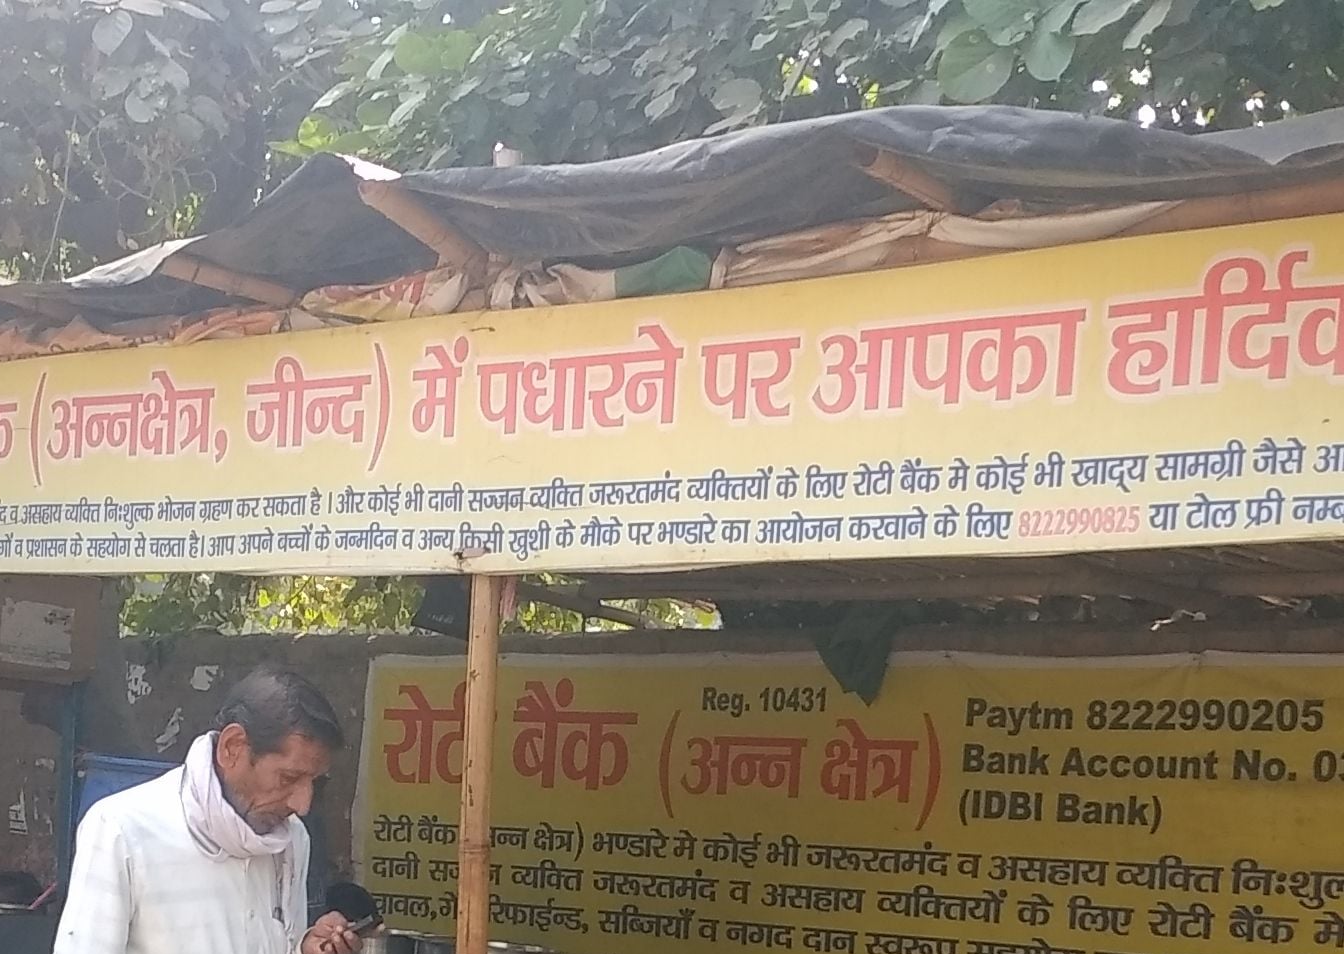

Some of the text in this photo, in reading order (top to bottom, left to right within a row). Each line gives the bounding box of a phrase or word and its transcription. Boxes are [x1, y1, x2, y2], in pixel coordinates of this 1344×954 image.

[30, 371, 229, 488] (अन्नक्षेत्र,
[246, 342, 390, 472] जीन्द)
[412, 336, 470, 438] में
[477, 326, 684, 435] पधारने
[701, 336, 801, 420] पर
[813, 308, 1087, 414] आपका
[20, 503, 62, 526] असहाय
[64, 496, 102, 524] व्यक्ति
[157, 495, 195, 523] भोजन
[198, 498, 234, 523] ग्रहण
[336, 485, 365, 515] और
[367, 482, 403, 517] कोई
[404, 482, 425, 514] भी
[428, 481, 464, 513] दानी
[467, 488, 525, 513] सज्जन
[528, 476, 586, 510] व्यक्ति
[588, 469, 682, 506] जरूरतमंद
[686, 465, 774, 502] व्यक्तियों
[775, 466, 800, 498] के
[805, 463, 848, 499] लिए
[853, 459, 895, 497] रोटी
[899, 456, 944, 493] बैंक
[975, 452, 1031, 495] कोई
[1033, 451, 1066, 488] भी
[1155, 439, 1246, 483] सामग्री
[1252, 436, 1307, 477] जैसे
[334, 521, 397, 551] जन्मदिन
[401, 529, 414, 550] व
[417, 526, 455, 552] अन्य
[508, 519, 551, 562] खुशी
[554, 515, 577, 549] के
[580, 515, 623, 548] मौके
[627, 520, 655, 546] पर
[656, 512, 718, 545] भण्डारे
[721, 518, 752, 544] का
[755, 510, 844, 544] आयोजन
[848, 504, 929, 542] करवाने
[932, 504, 960, 539] के
[965, 501, 1014, 540] लिए
[1017, 504, 1141, 539] 8222990825
[1148, 502, 1180, 533] या
[1185, 492, 1238, 530] टोल
[512, 678, 639, 790] बैंक
[701, 687, 827, 718] Reg. 10431
[965, 698, 1324, 736] Paytm 8222990205
[658, 710, 942, 831] (अन्न क्षेत्र)
[962, 743, 1050, 776] Bank
[1060, 749, 1219, 781] Account
[1232, 750, 1298, 782] No.
[958, 788, 1163, 834] (IDBI Bank)
[373, 814, 414, 843] रोटी
[533, 821, 585, 862] क्षेत्र)
[592, 828, 670, 859] भण्डारे
[702, 832, 763, 869] कोई
[766, 835, 801, 868] भी
[806, 840, 949, 877] जरूरतमंद
[956, 853, 982, 880] व
[989, 854, 1110, 887] असहाय
[1115, 854, 1224, 895] व्यक्ति
[372, 850, 421, 881] दानी
[510, 858, 585, 892] व्यक्ति
[592, 868, 720, 902] जरूरतमंद
[729, 879, 751, 905] व
[760, 881, 866, 914] असहाय
[876, 884, 1008, 925] व्यक्तियों
[1016, 893, 1055, 927] के
[1067, 895, 1135, 936] लिए
[1147, 901, 1215, 941] रोटी
[1228, 904, 1299, 945] बैंक
[698, 918, 720, 942] व
[725, 919, 794, 950] नगद
[802, 926, 858, 954] दान
